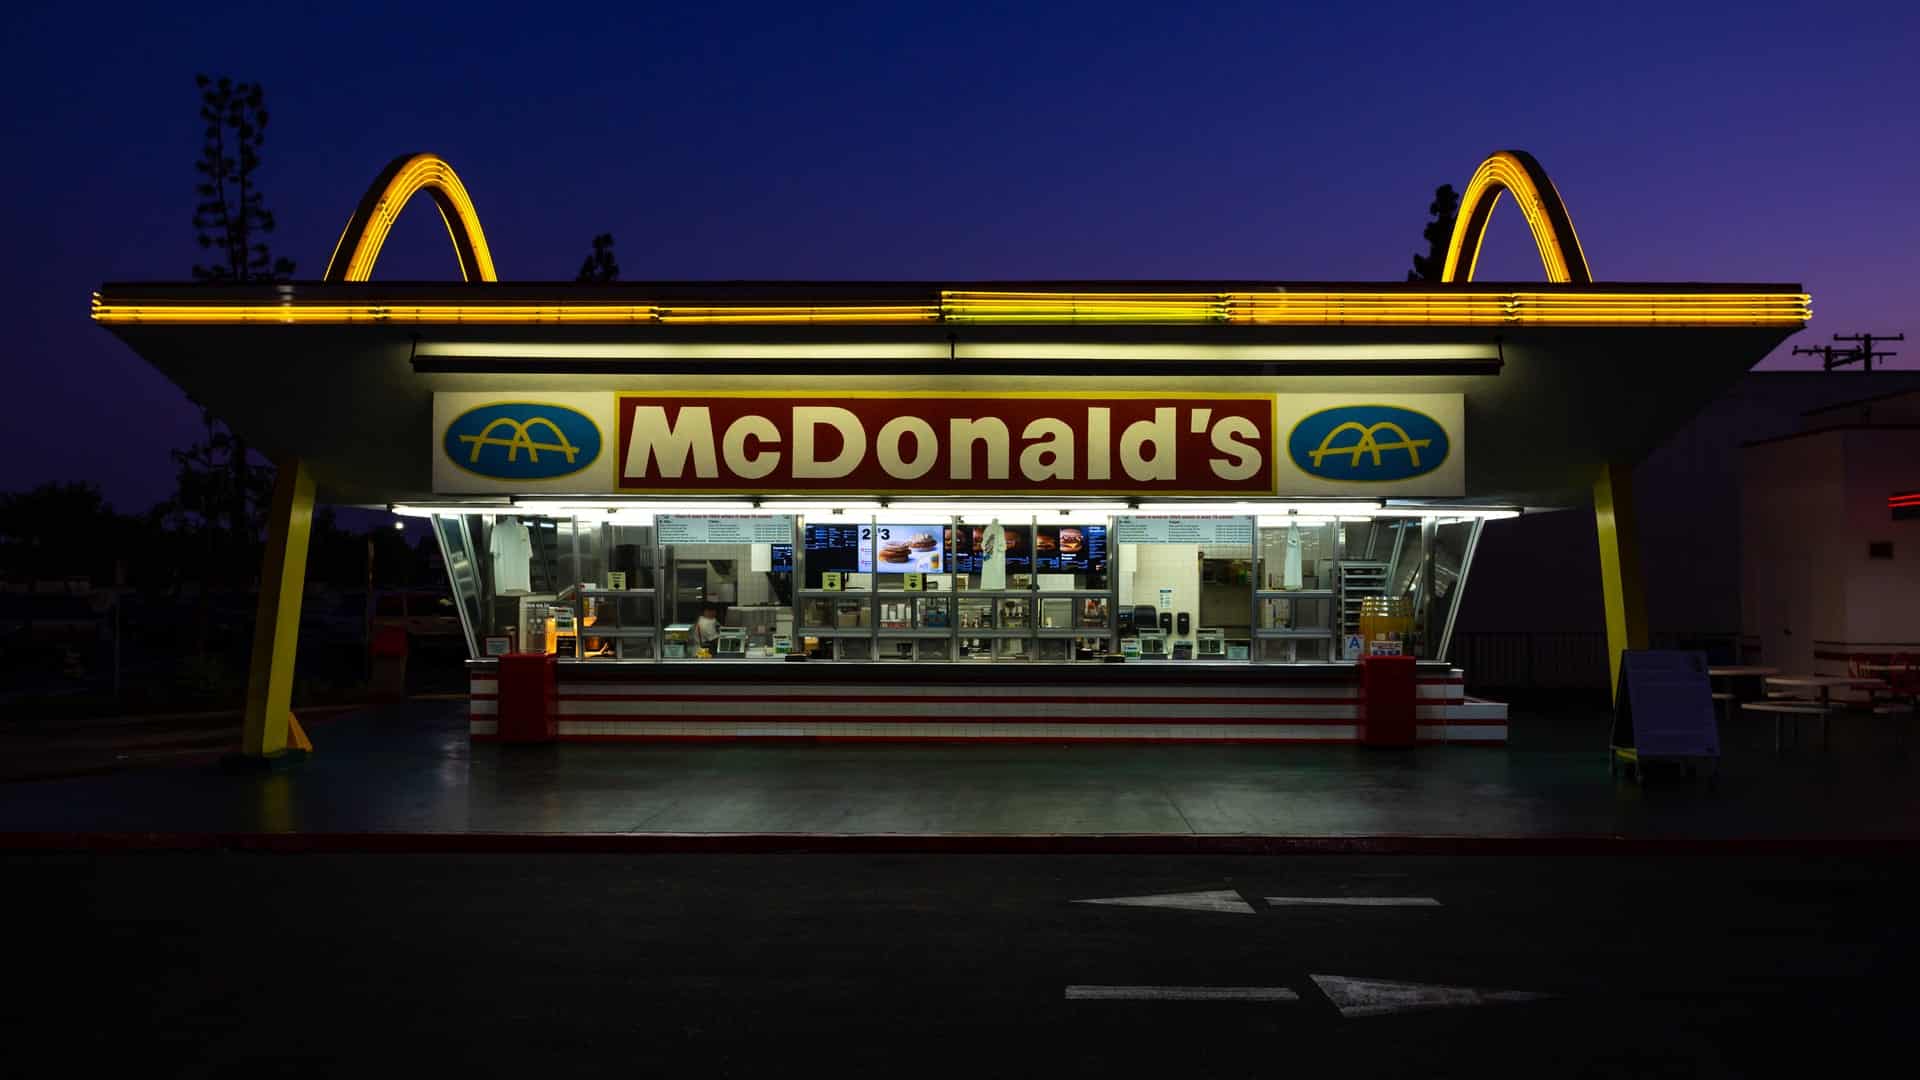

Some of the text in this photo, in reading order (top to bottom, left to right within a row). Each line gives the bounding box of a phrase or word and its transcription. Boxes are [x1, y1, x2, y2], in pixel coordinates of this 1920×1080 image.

[624, 406, 1261, 480] McDonald's
[862, 528, 871, 540] 2
[1349, 636, 1360, 648] A
